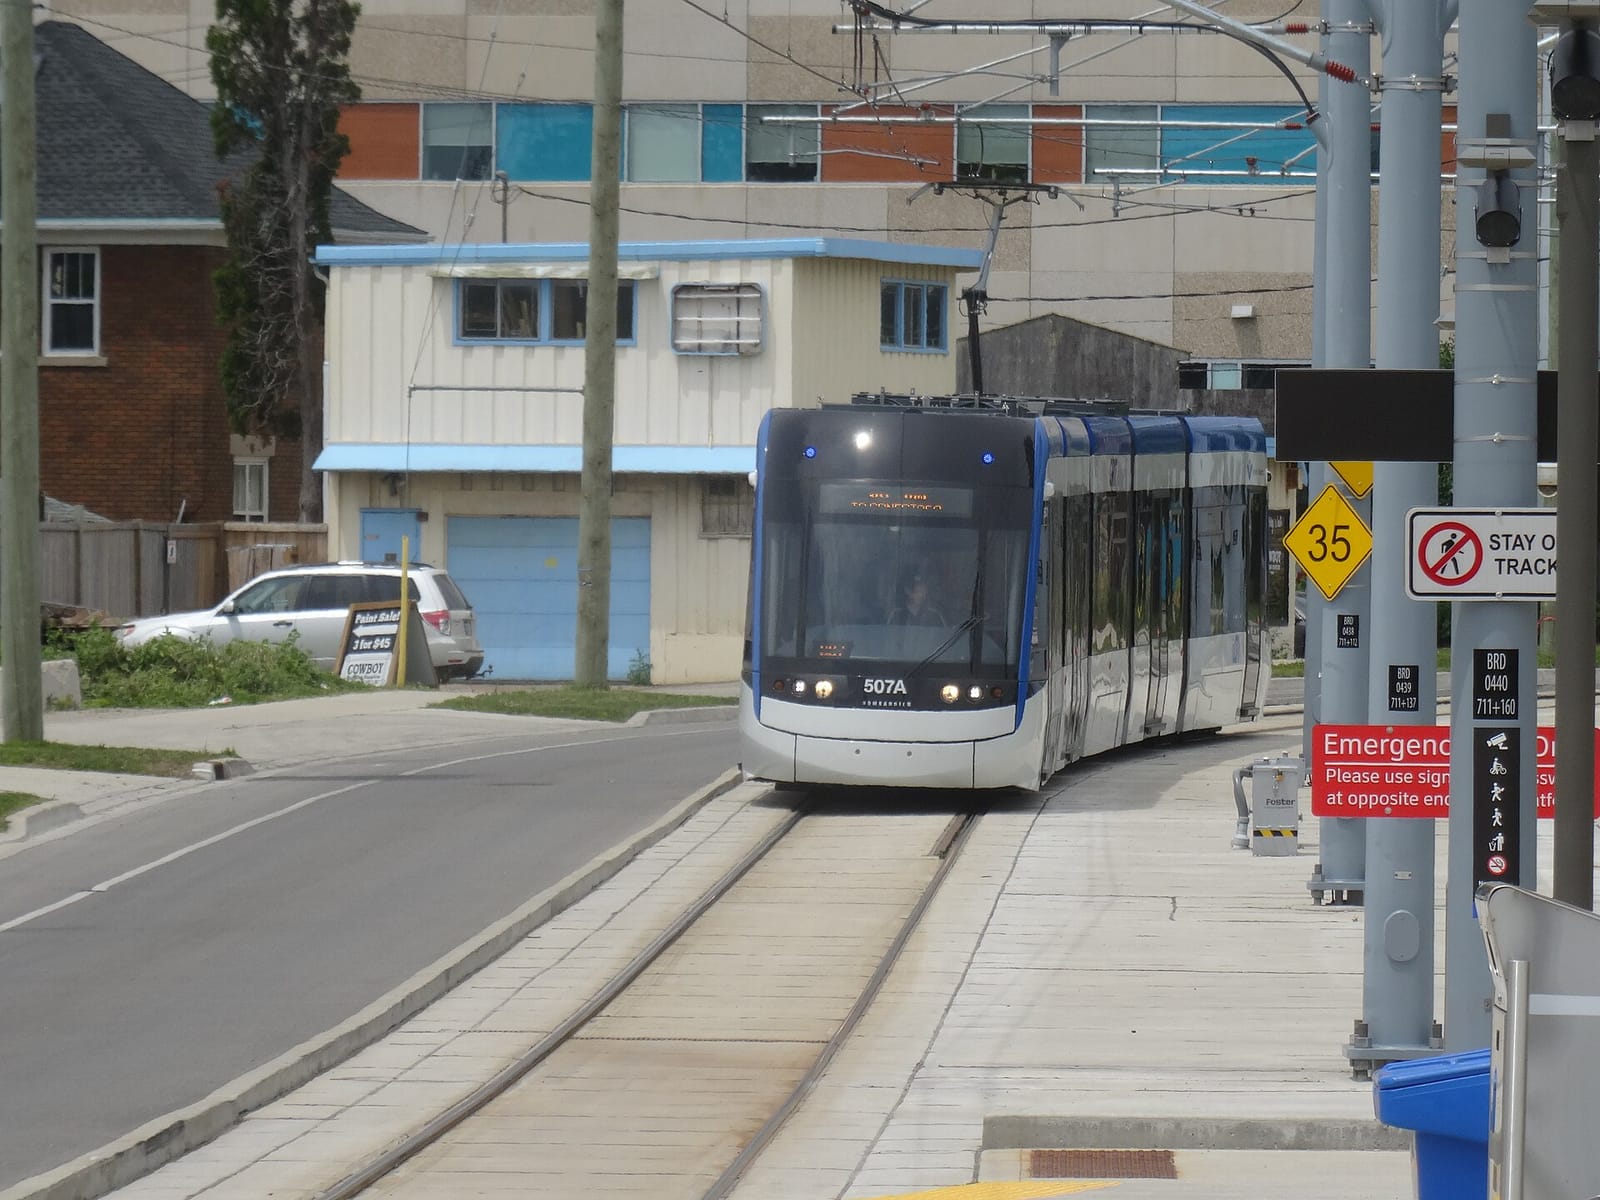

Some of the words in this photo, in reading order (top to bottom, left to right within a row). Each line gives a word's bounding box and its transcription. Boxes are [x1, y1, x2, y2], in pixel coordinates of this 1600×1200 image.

[1308, 524, 1351, 562] 35
[1489, 534, 1536, 551] STAY
[355, 613, 377, 623] Paint
[353, 640, 359, 649] 3
[360, 639, 371, 649] for
[372, 638, 390, 649] $45
[348, 663, 383, 674] COWBOY
[1487, 653, 1506, 670] BRD
[1397, 668, 1410, 680] BRD
[864, 679, 907, 694] 507A
[1396, 682, 1412, 694] 0439
[1484, 674, 1508, 692] 0440
[1390, 697, 1416, 709] 711+137
[1477, 698, 1516, 716] 711+160
[1326, 769, 1382, 784] Please
[1385, 773, 1413, 784] use
[1266, 798, 1296, 806] Foster
[1327, 793, 1342, 805] at
[1349, 792, 1419, 809] opposite
